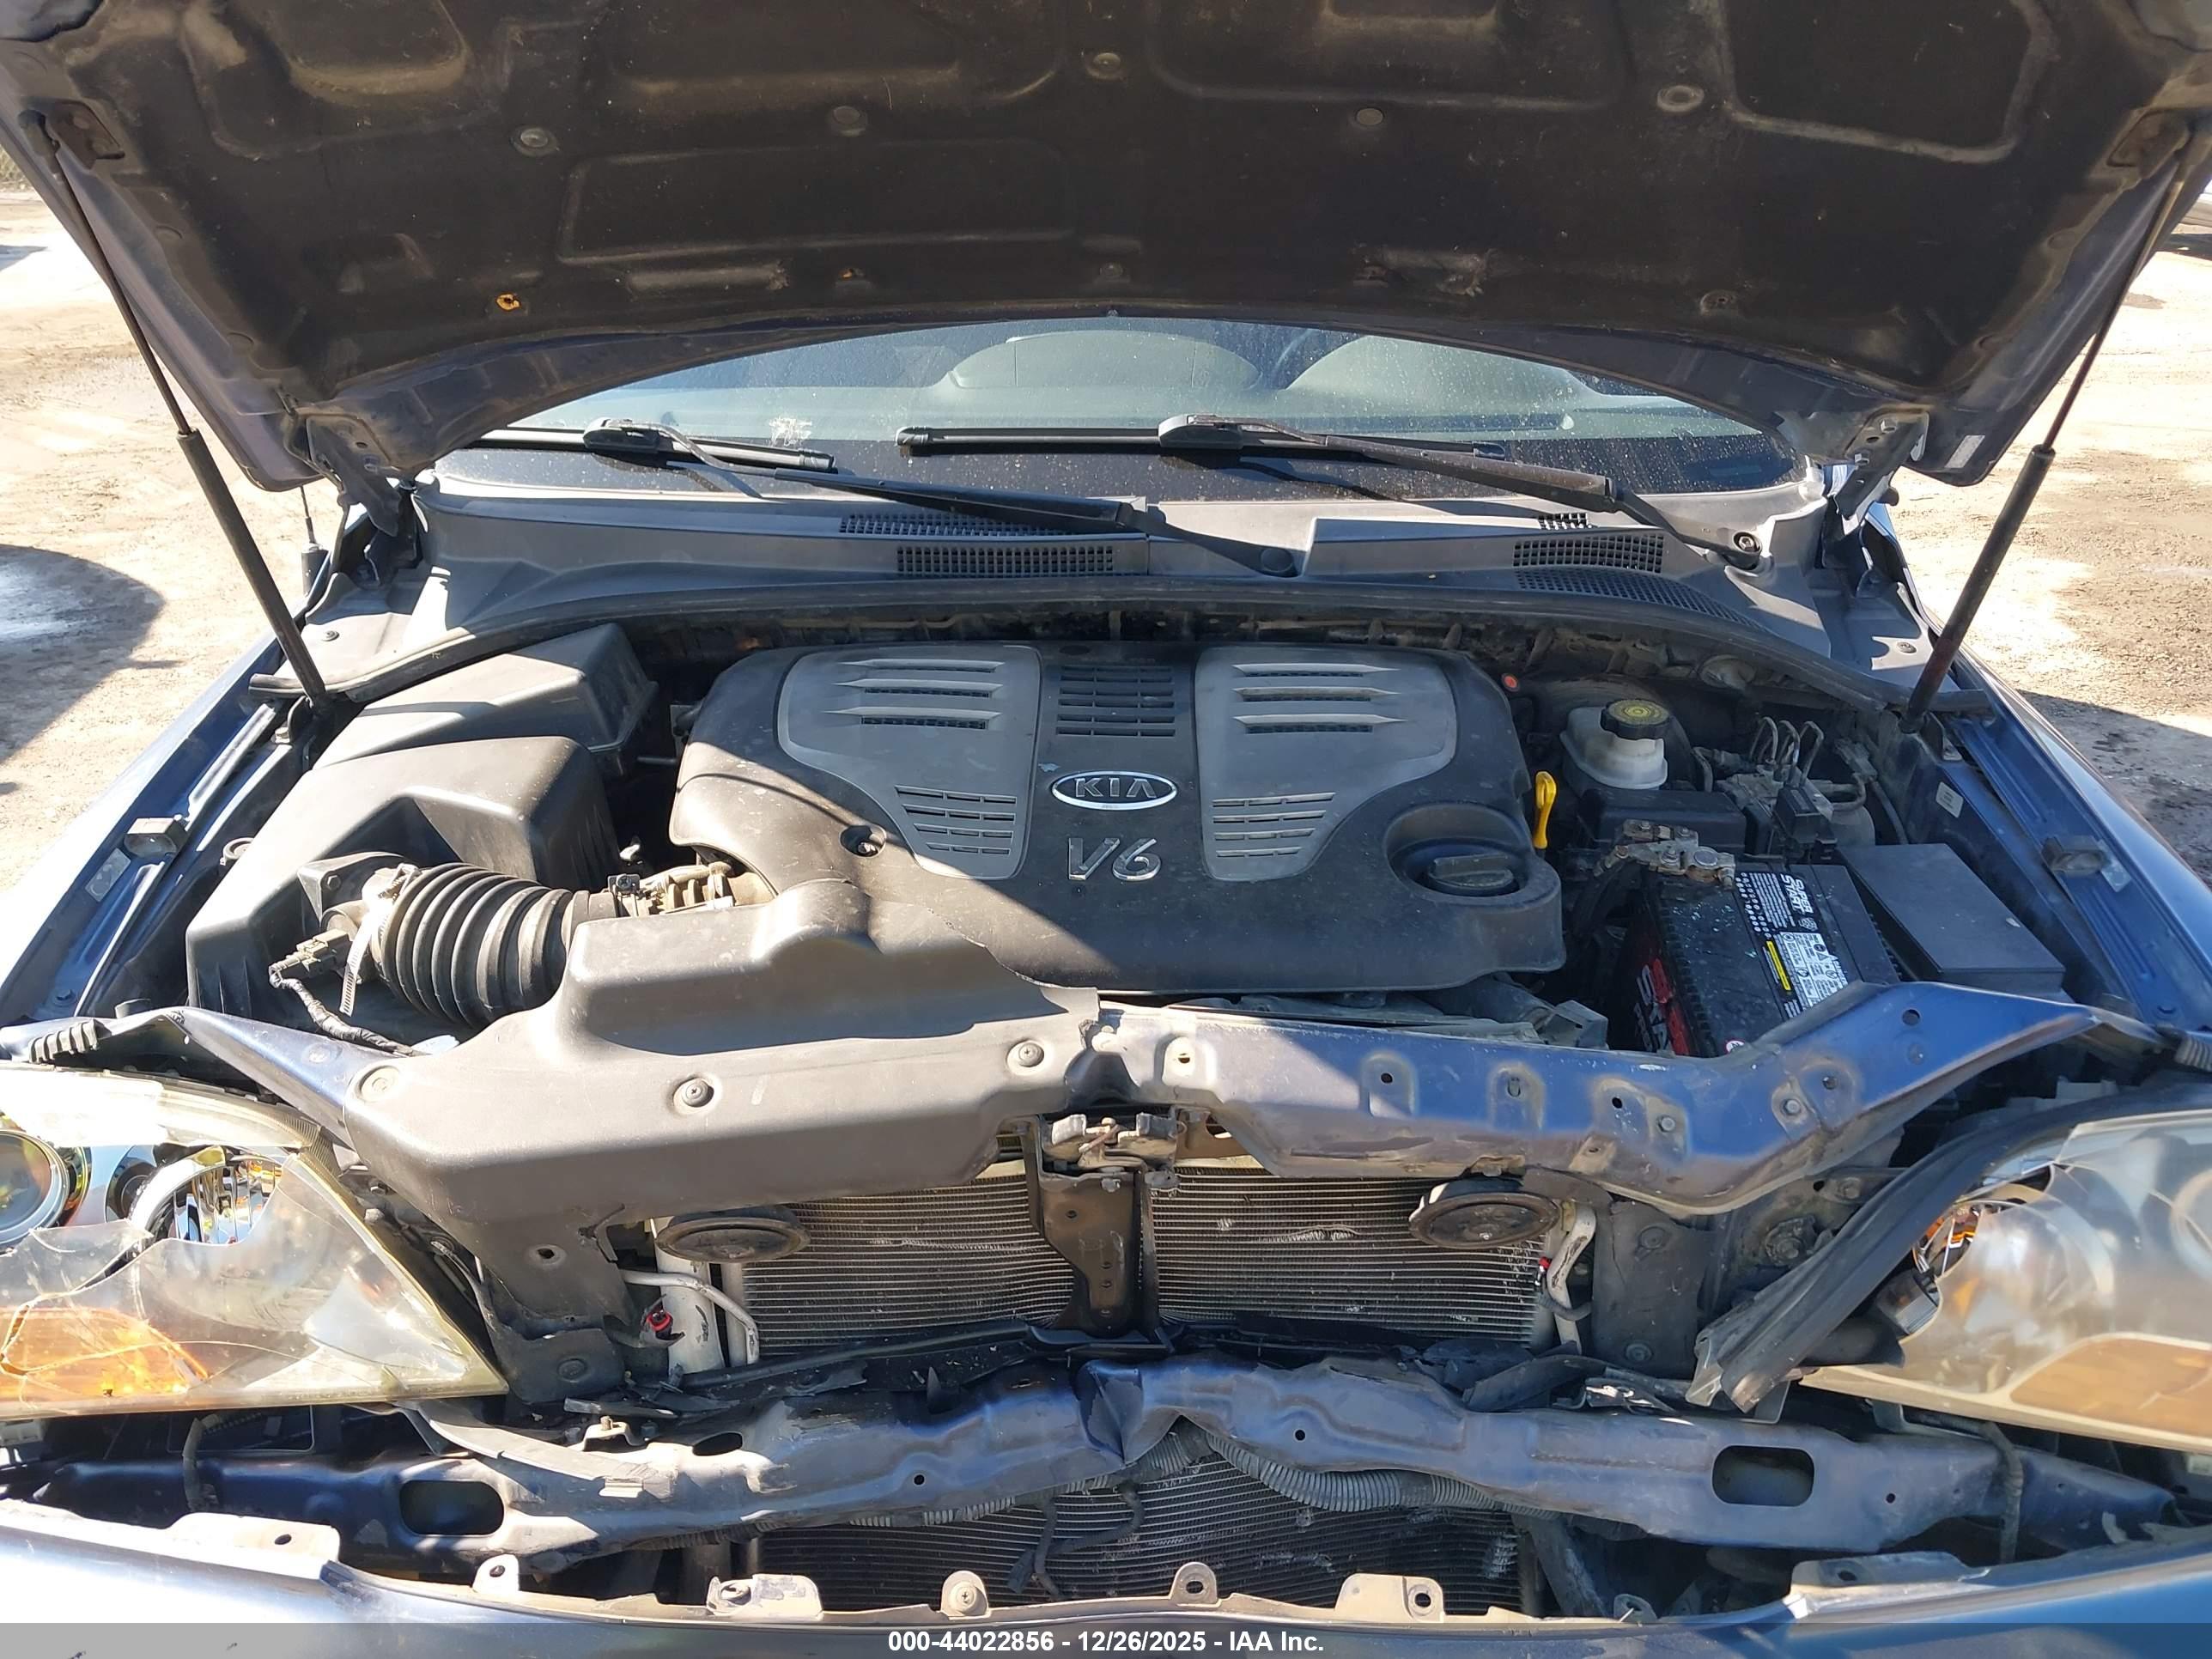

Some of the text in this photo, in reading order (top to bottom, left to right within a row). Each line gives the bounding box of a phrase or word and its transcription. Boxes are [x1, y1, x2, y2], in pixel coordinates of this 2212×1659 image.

[1075, 777, 1157, 798] KIA
[1068, 837, 1162, 882] V6
[1780, 873, 1802, 914] START
[1795, 878, 1814, 914] SUPER
